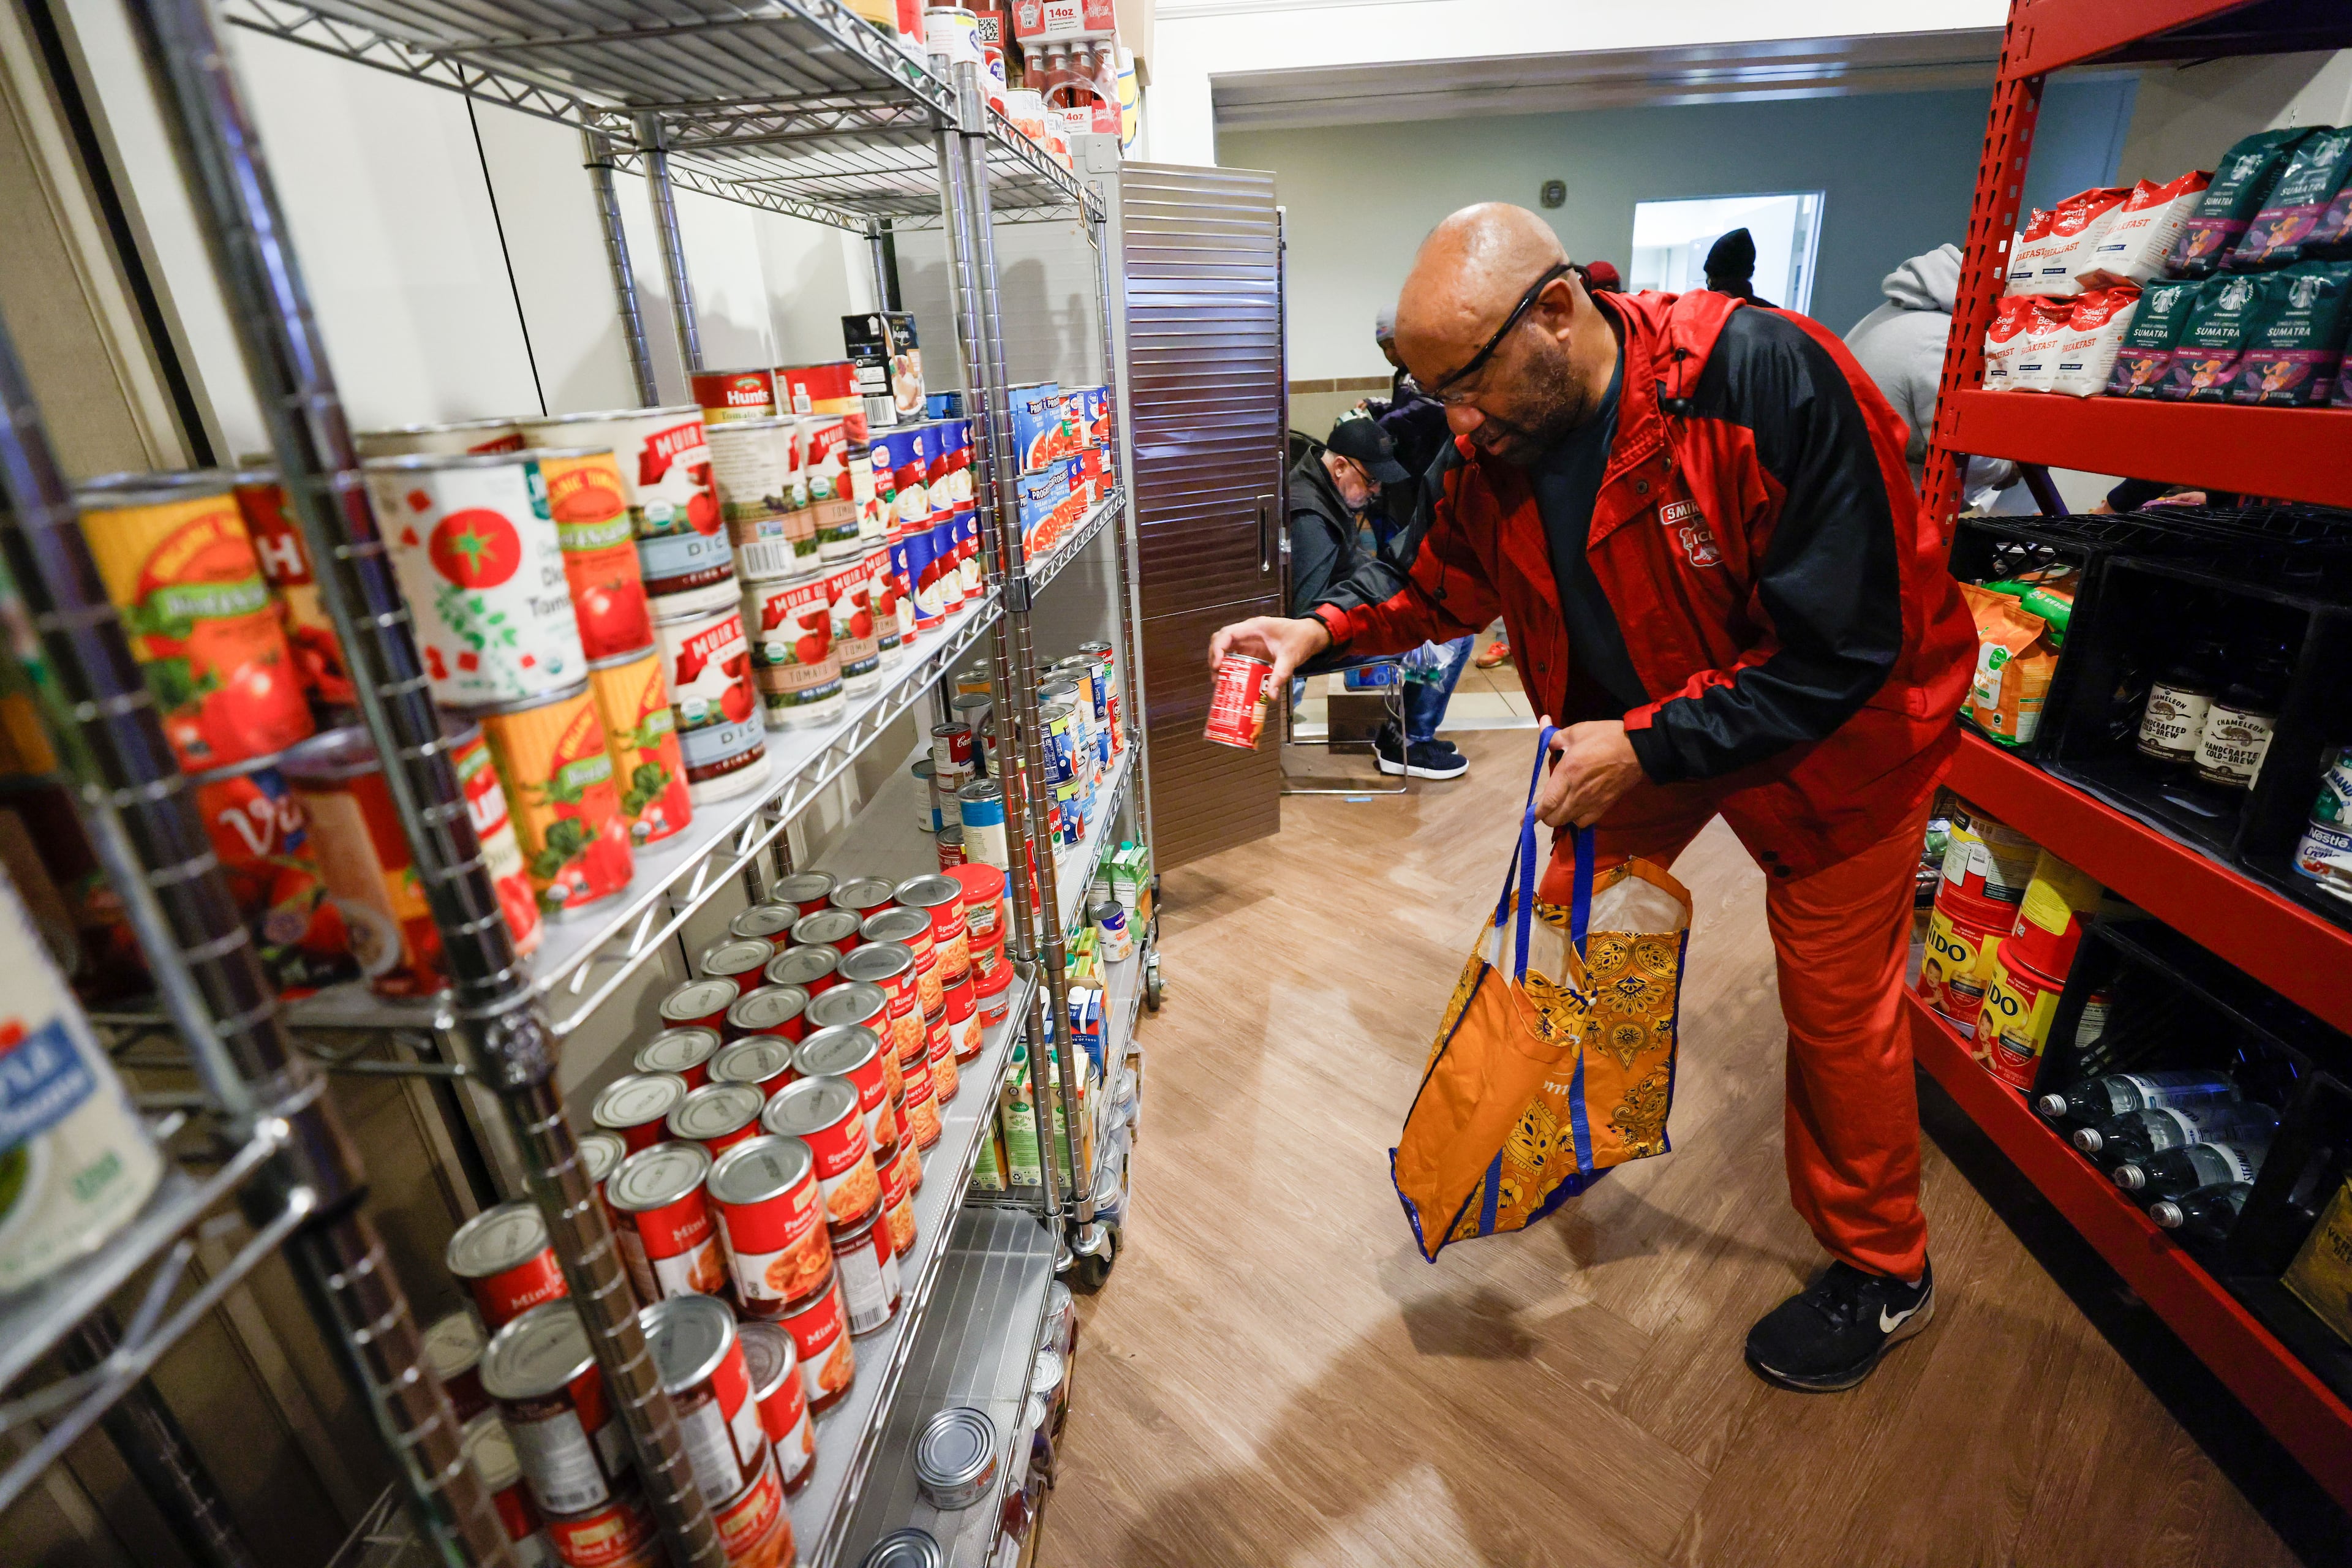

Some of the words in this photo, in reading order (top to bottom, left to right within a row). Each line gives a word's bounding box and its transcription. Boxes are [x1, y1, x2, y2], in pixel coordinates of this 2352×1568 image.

[1049, 8, 1074, 18] 14oz
[2280, 183, 2326, 196] SUMATRA
[2204, 197, 2233, 206] SUMATRA
[2133, 328, 2168, 338] SUMATRA
[2195, 327, 2240, 337] SUMATRA
[2267, 327, 2311, 336] SUMATRA
[2061, 337, 2097, 353] BREAKFAST
[774, 587, 812, 613] MUIR
[2151, 695, 2187, 710] CHAMELEON
[2217, 719, 2266, 734] CHAMELEON
[2206, 749, 2256, 765] COLD-BREW
[1961, 931, 1982, 941] Beverage
[2014, 977, 2029, 989] Toddler
[2015, 982, 2036, 996] Beverage
[2004, 1038, 2028, 1052] PROBIOTIC
